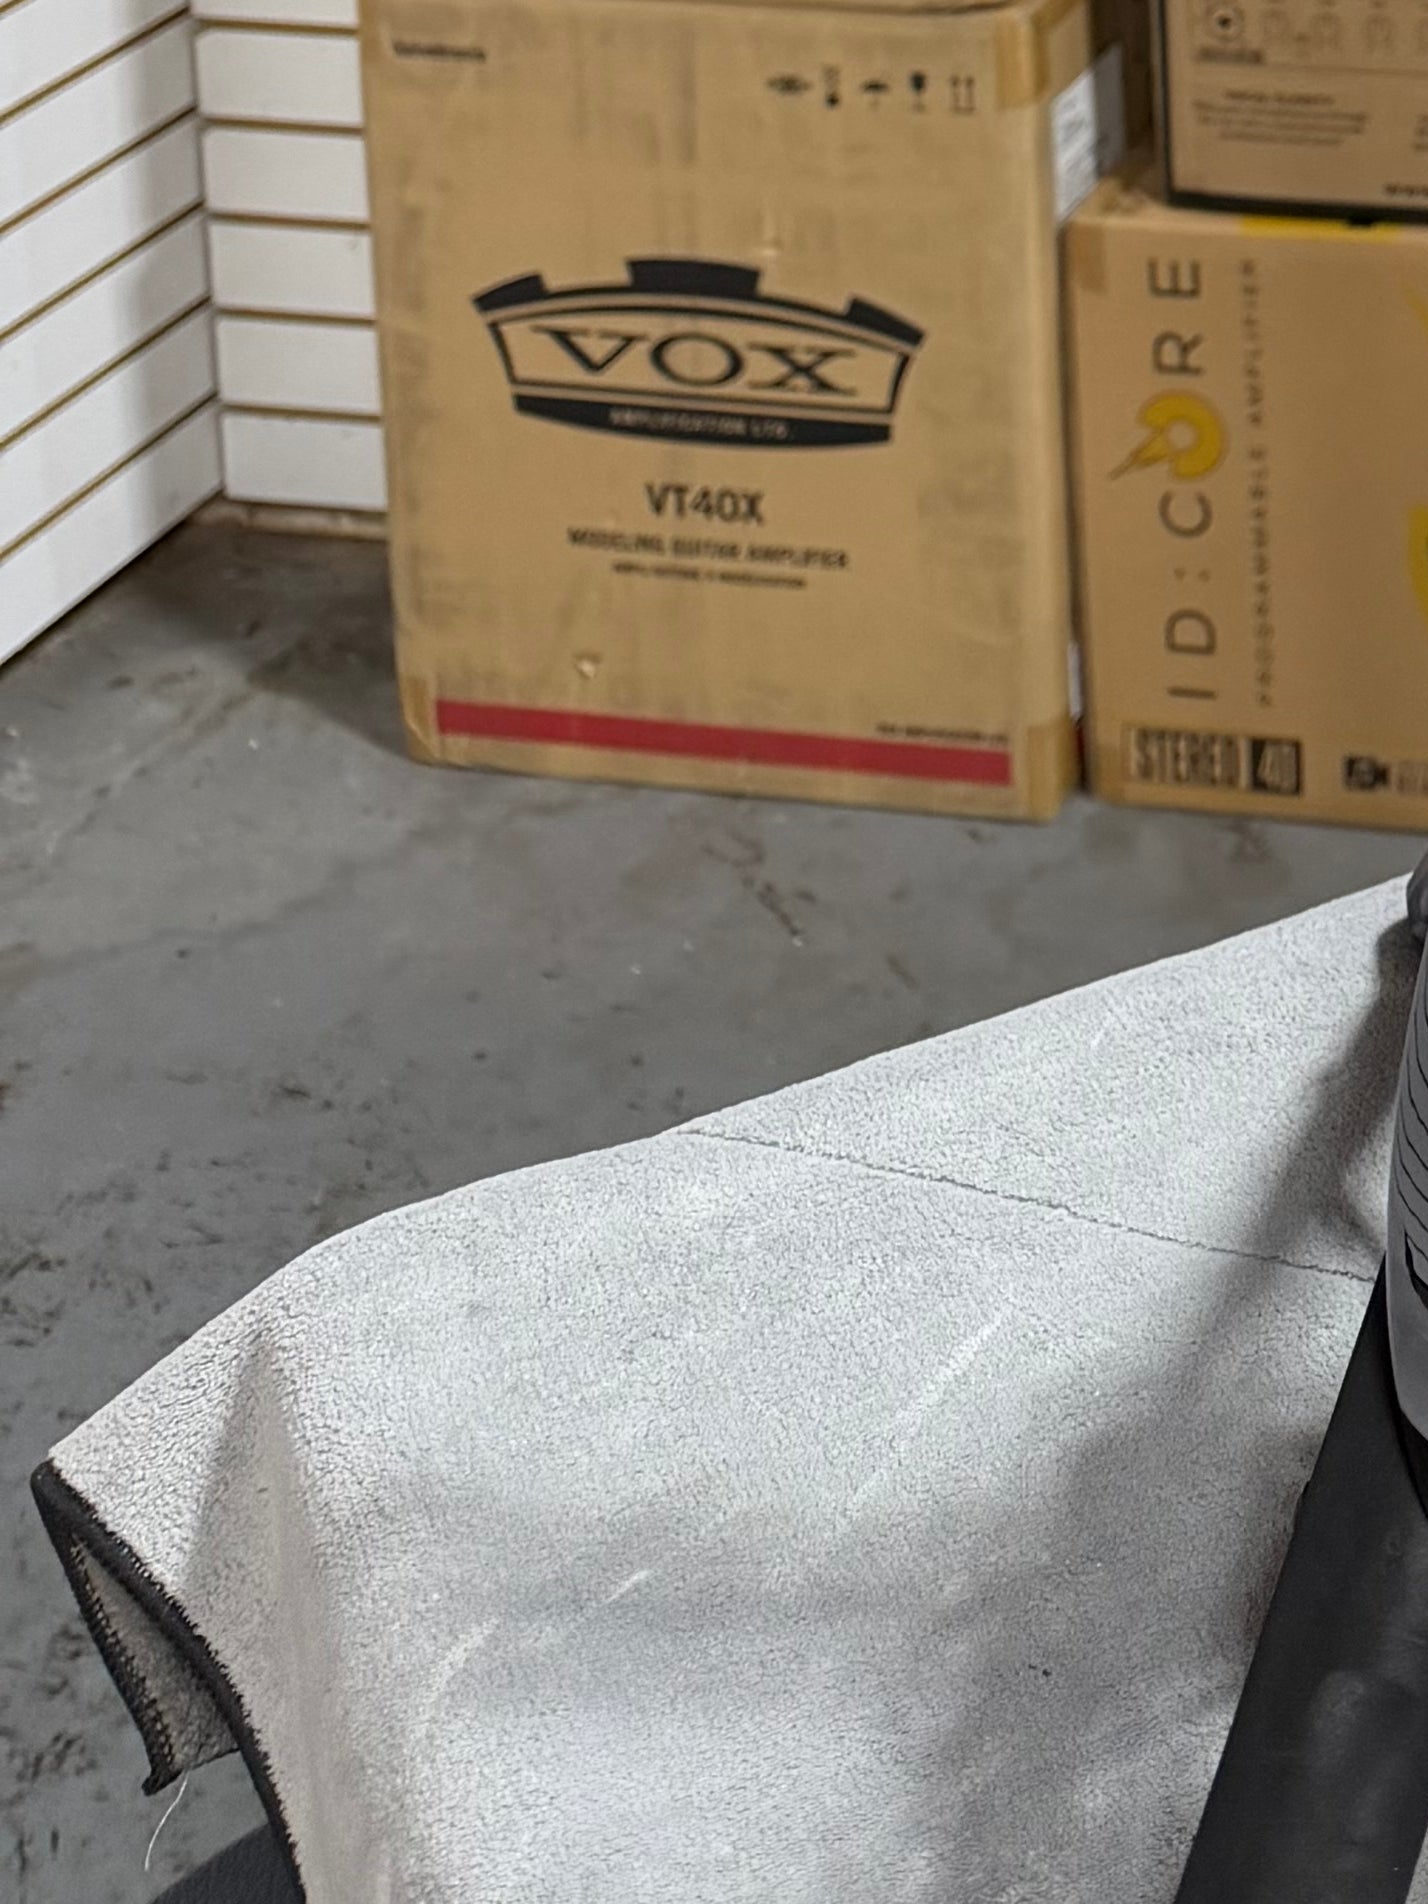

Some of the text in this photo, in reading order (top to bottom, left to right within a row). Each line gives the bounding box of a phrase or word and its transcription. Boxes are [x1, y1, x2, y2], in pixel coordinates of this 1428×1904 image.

[530, 324, 857, 397] VOX
[645, 481, 766, 526] VT40X
[1134, 727, 1244, 787] STEREO
